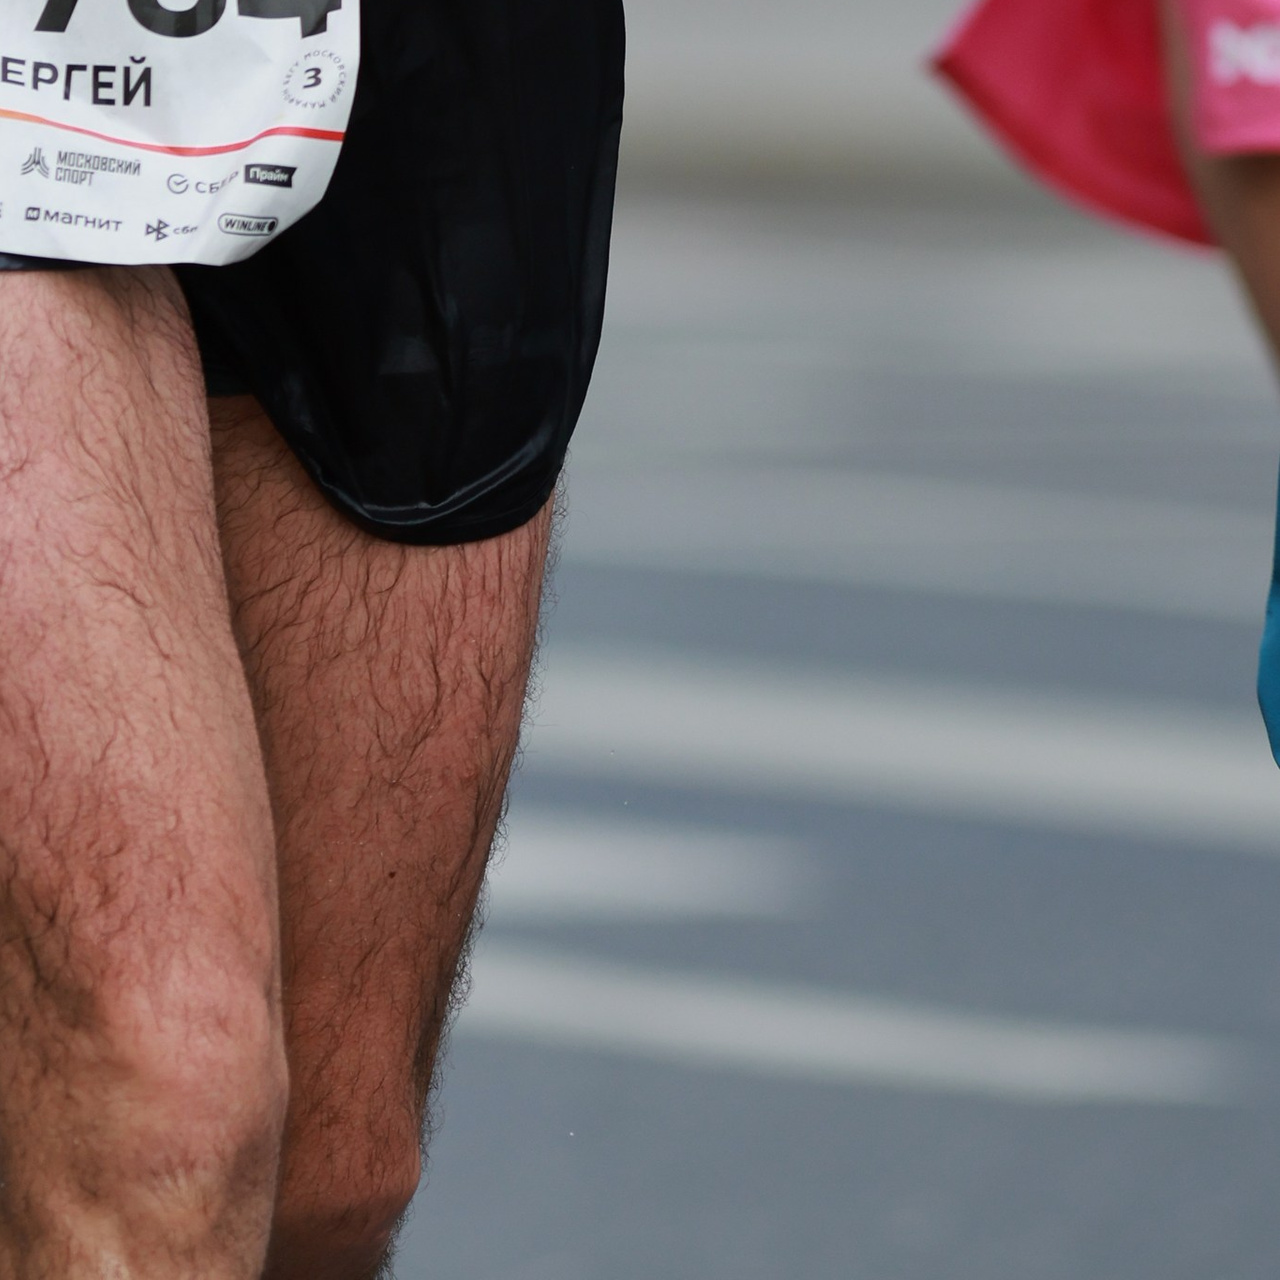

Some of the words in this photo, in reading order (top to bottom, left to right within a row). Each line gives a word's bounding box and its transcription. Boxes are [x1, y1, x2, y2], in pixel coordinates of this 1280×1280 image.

[302, 66, 323, 90] 3
[56, 149, 142, 177] МОСКОВСКИЙ
[54, 166, 95, 187] СПОРТ
